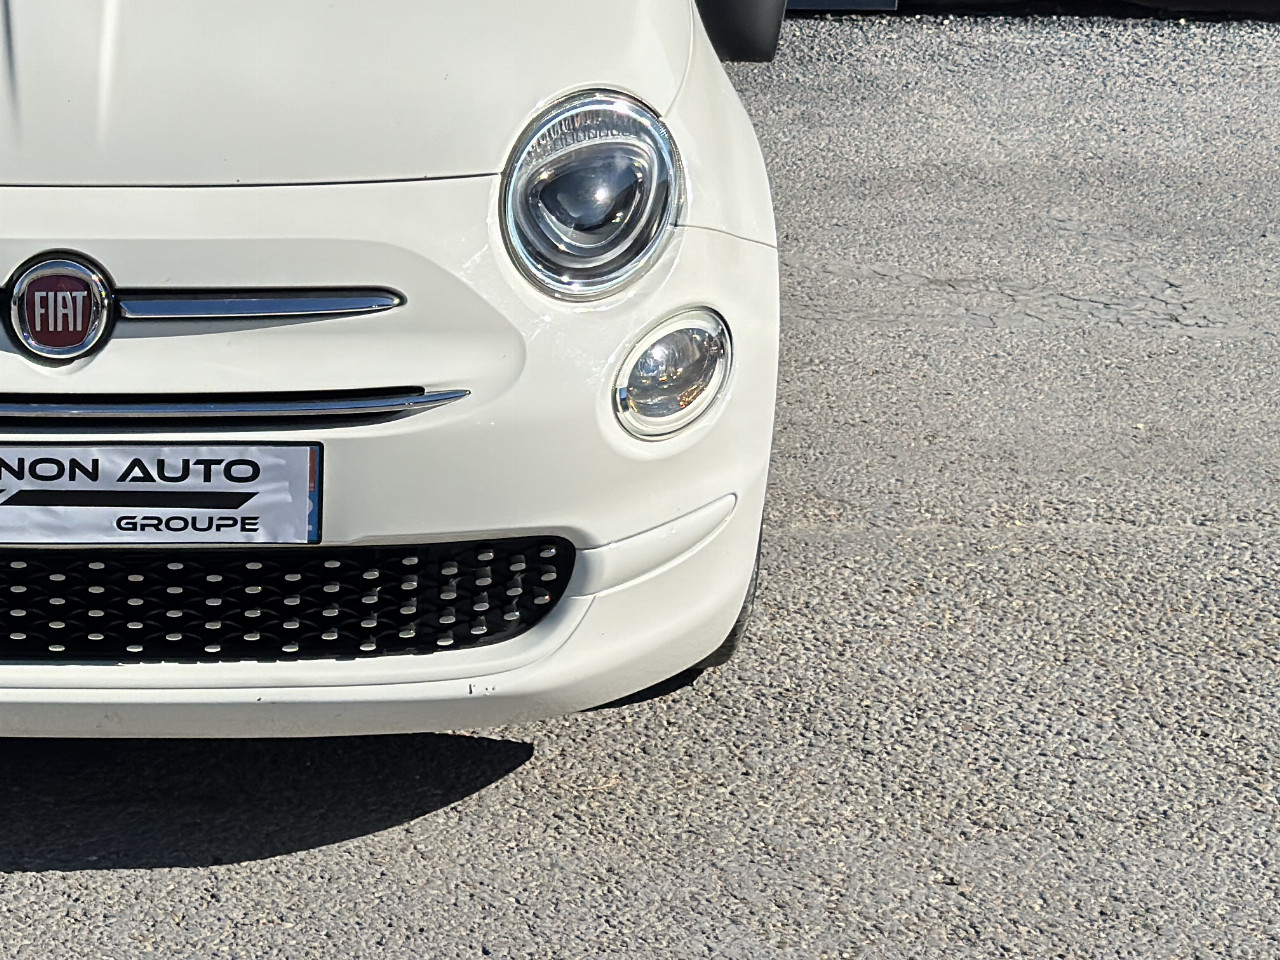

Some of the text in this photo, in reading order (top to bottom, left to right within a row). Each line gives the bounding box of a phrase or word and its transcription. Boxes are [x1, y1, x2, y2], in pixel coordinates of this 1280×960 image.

[34, 290, 88, 332] FIAT
[116, 458, 260, 483] AUTO
[116, 516, 259, 532] GROUPE
